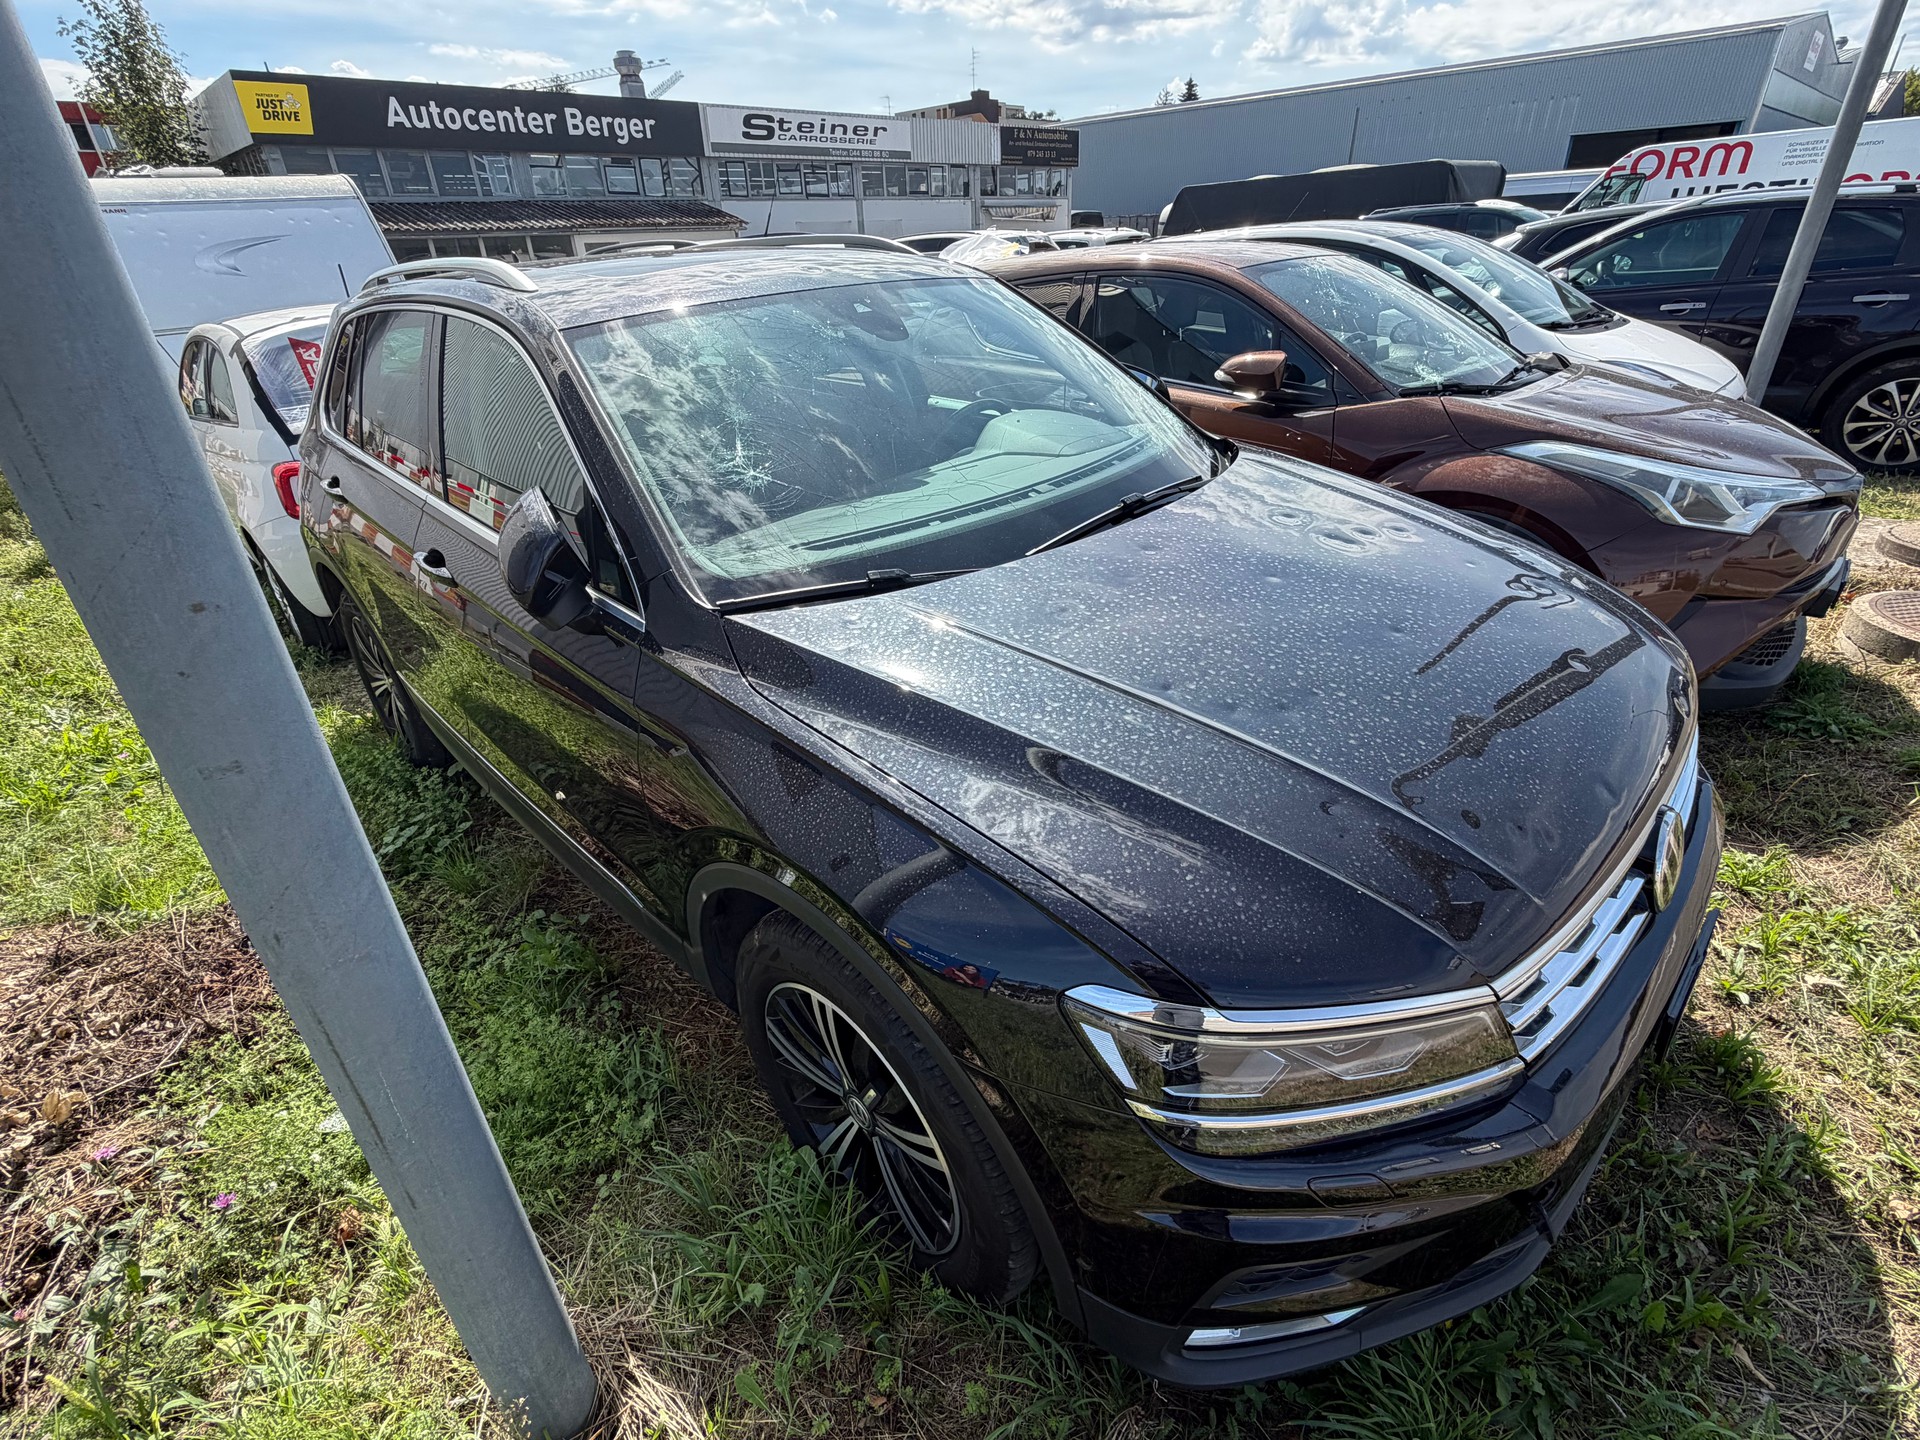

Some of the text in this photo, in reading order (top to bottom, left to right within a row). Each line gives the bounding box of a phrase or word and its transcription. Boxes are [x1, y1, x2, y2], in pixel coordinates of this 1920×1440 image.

[256, 98, 284, 109] JUST
[262, 110, 300, 122] DRIVE
[387, 96, 656, 145] Autocenter Berger
[742, 113, 888, 141] Steiner
[778, 134, 877, 145] CARROSSERIE
[1014, 129, 1068, 140] F & N Automobile
[1788, 139, 1825, 147] SCHWEIZER
[829, 148, 848, 156] Telefon
[1783, 152, 1825, 160] MARKENERLE
